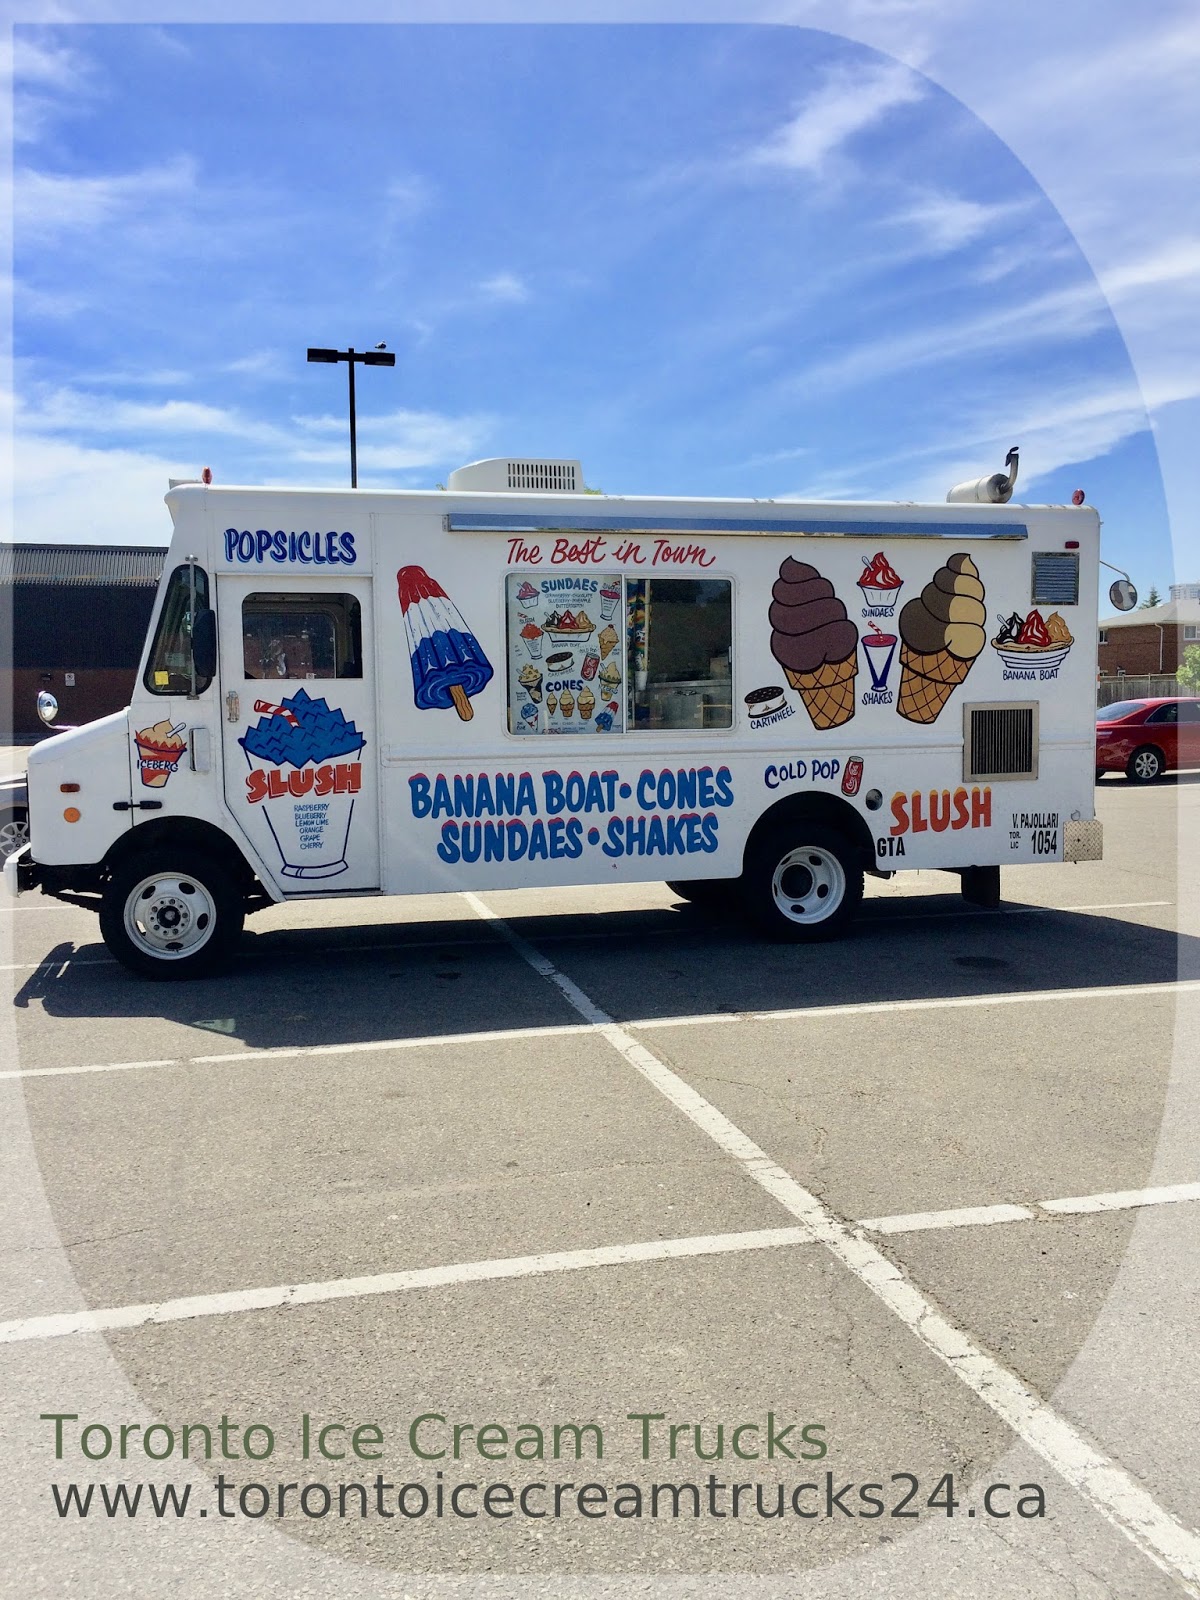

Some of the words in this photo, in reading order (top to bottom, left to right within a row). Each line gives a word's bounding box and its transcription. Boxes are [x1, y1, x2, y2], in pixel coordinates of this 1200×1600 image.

[224, 528, 357, 565] POPSICLES
[507, 538, 543, 564] The
[551, 536, 607, 564] Best
[612, 540, 647, 564] in
[651, 539, 716, 567] Town
[541, 577, 599, 593] SUNDAES
[862, 607, 895, 618] SUNDAES
[1002, 670, 1037, 681] BANANA
[1039, 668, 1060, 680] BOAT
[545, 680, 584, 693] CONES
[862, 691, 893, 705] SHAKES
[750, 706, 796, 730] CARTWHEEL
[136, 759, 179, 772] ICEBERG
[764, 760, 807, 789] COLD
[811, 758, 840, 781] POP
[246, 763, 362, 804] SLUSH
[409, 772, 537, 819] BANANA
[542, 769, 619, 814] BOAT
[636, 766, 734, 811] CONES
[294, 803, 330, 812] RASPBERRY
[890, 787, 992, 836] SLUSH
[295, 812, 327, 820] BLUEBERRY
[1012, 813, 1019, 829] V.
[1020, 812, 1059, 829] PAJOLLARI
[299, 826, 324, 834] ORANGE
[437, 819, 583, 864] SUNDAES
[602, 812, 718, 858] SHAKES
[300, 841, 324, 850] CHERRY
[877, 837, 905, 857] GTA
[1010, 841, 1019, 849] LIC
[1031, 829, 1057, 855] 1054
